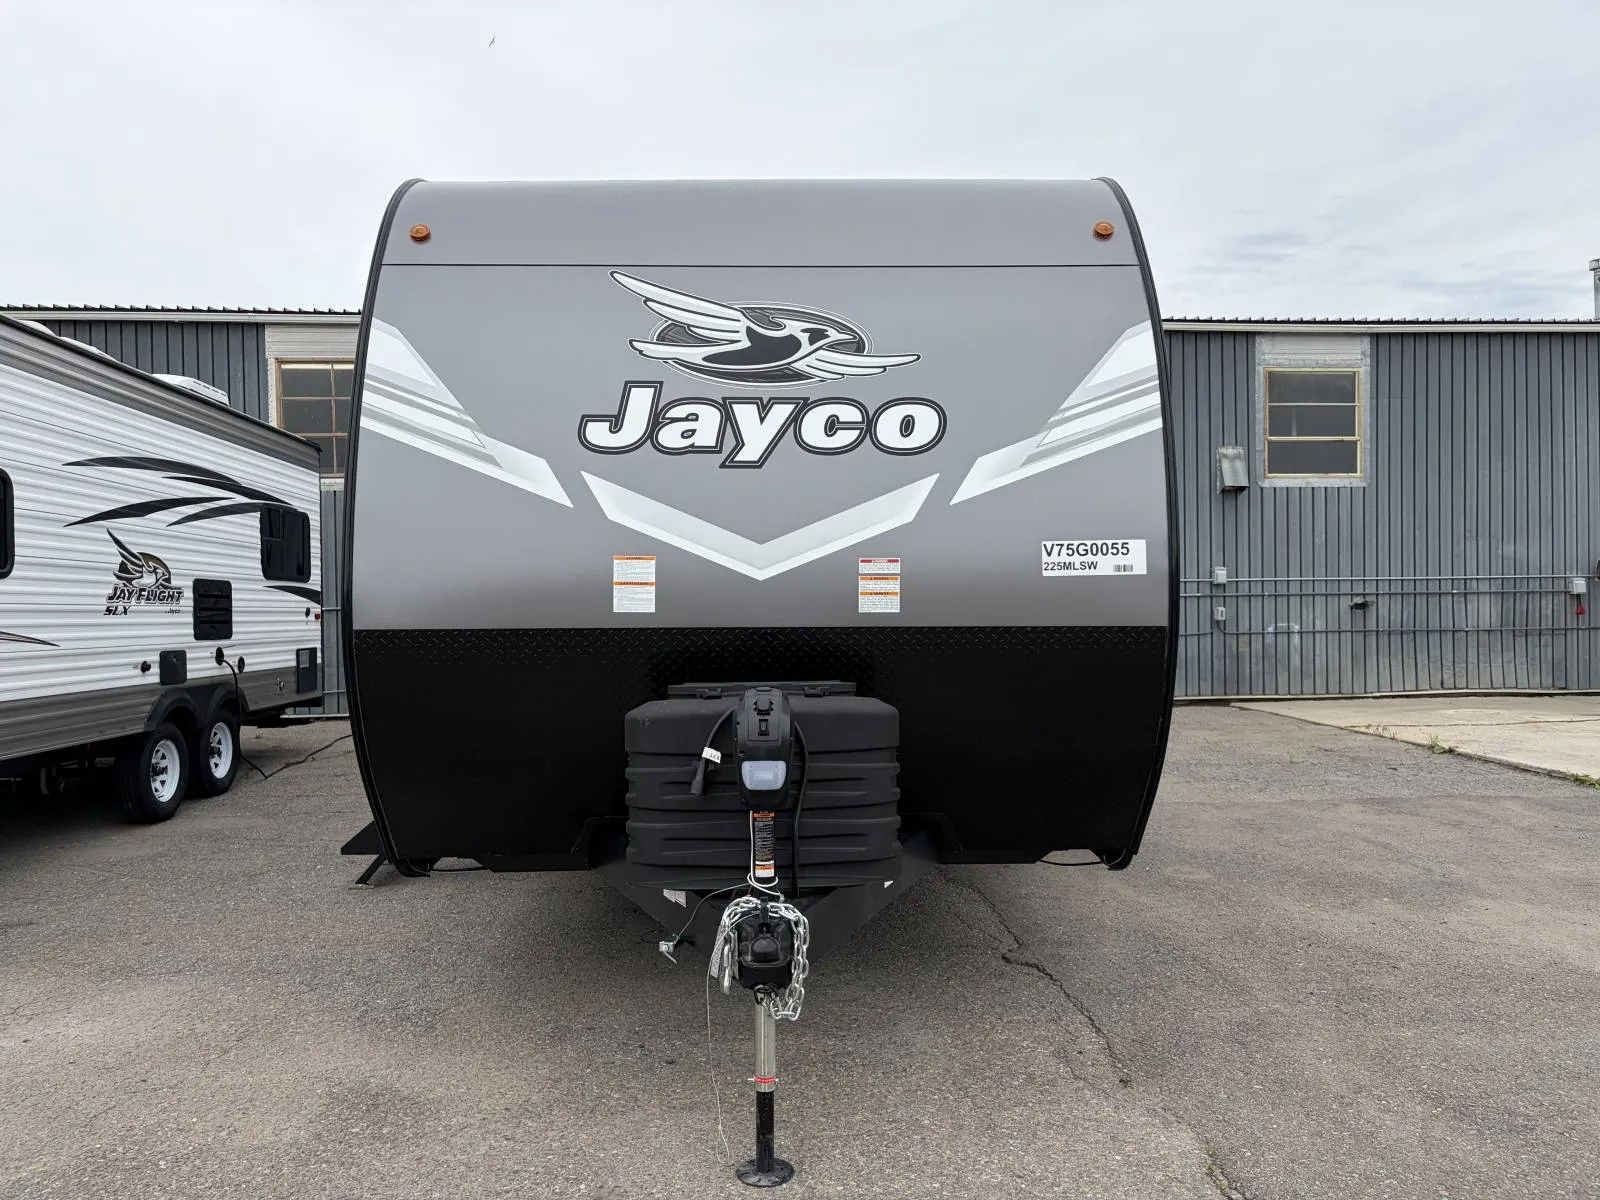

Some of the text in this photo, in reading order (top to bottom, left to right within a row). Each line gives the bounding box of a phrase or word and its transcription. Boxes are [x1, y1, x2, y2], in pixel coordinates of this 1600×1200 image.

[578, 381, 947, 468] Jayco
[1043, 542, 1130, 557] V75G0055
[1043, 561, 1098, 571] 225MLSW
[107, 584, 183, 604] JAY FLIGHT
[104, 605, 131, 616] SLX
